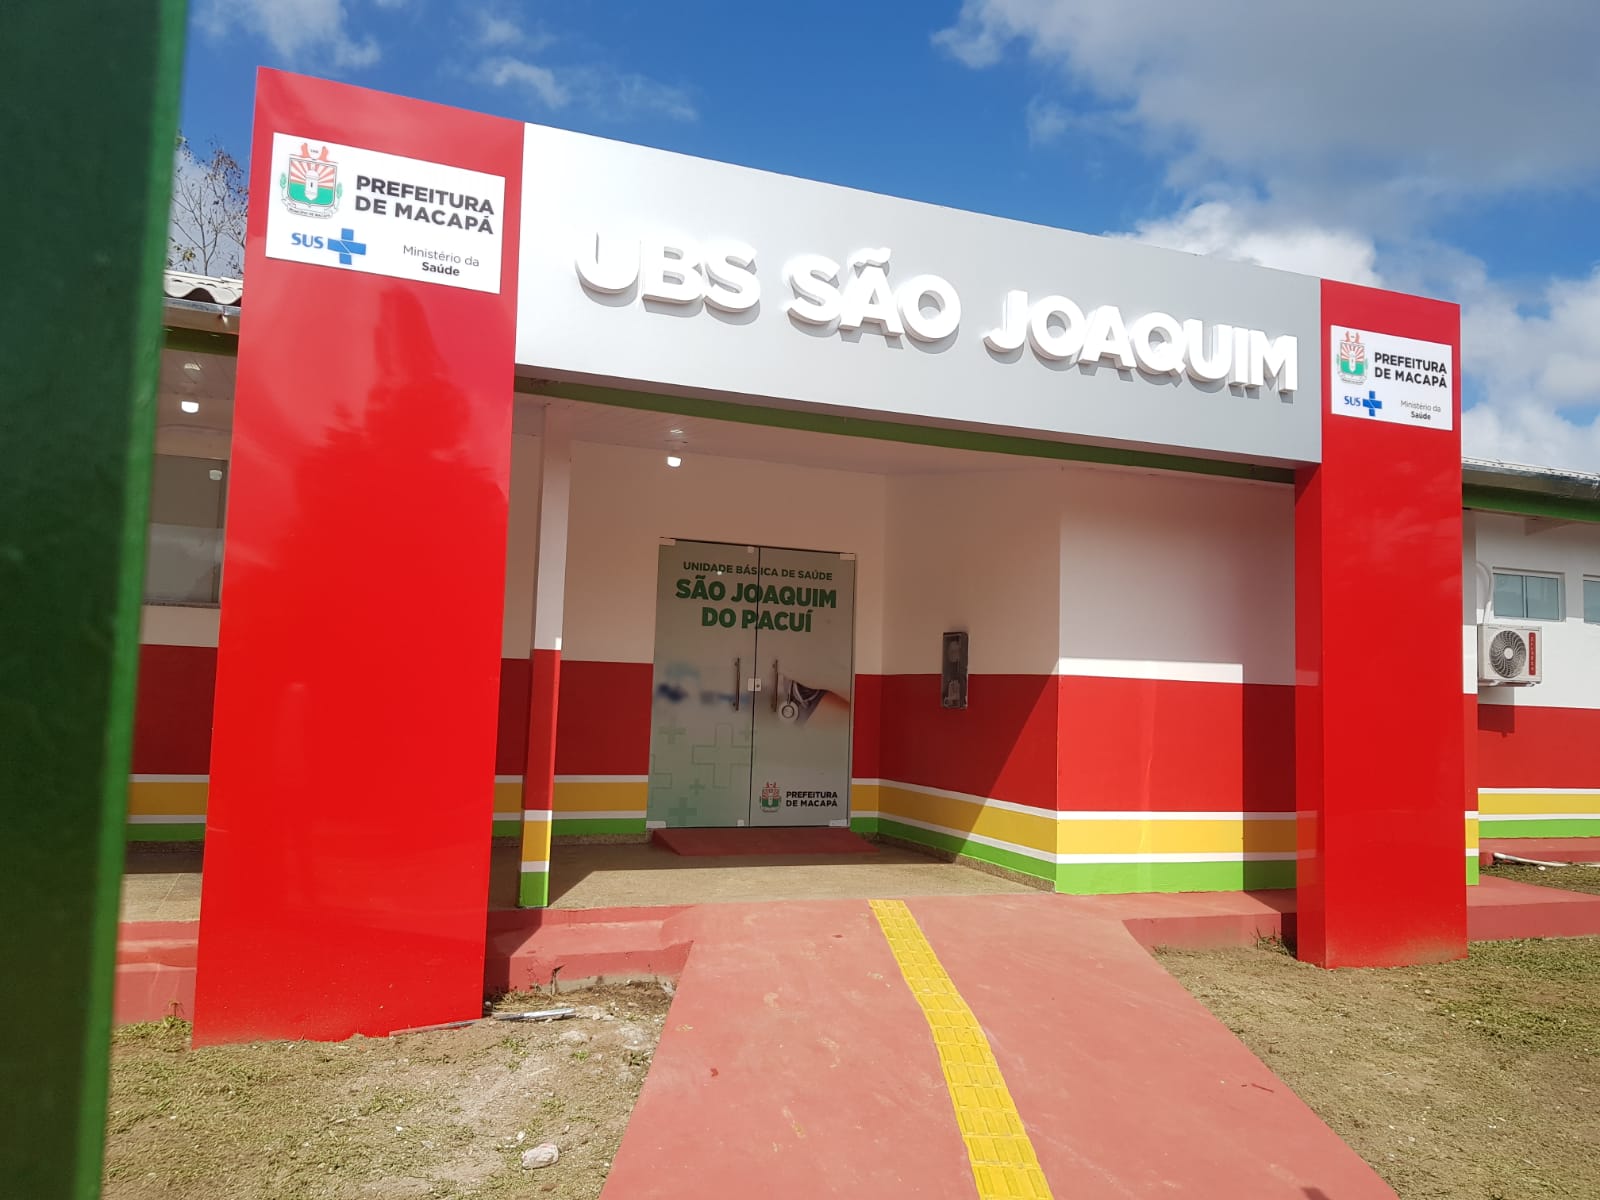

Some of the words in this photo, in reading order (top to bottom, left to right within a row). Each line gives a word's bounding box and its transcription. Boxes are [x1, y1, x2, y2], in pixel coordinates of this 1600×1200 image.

[356, 174, 494, 215] PREFEITURA
[355, 195, 387, 216] DE
[395, 202, 494, 235] MACAPÁ
[290, 232, 324, 249] SUS
[402, 245, 462, 264] Ministério
[464, 255, 480, 267] da
[421, 261, 460, 277] Saúde
[575, 232, 760, 314] UBS
[784, 247, 961, 342] SÃO
[982, 289, 1298, 395] JOAQUIM
[1374, 352, 1447, 374] PREFEITURA
[1374, 367, 1392, 380] DE
[1395, 370, 1448, 388] MACAPÁ
[1344, 395, 1361, 407] SUS
[1400, 400, 1432, 411] Ministério
[1432, 404, 1442, 413] da
[1410, 410, 1431, 421] Saúde
[683, 561, 733, 574] UNIDADE
[736, 564, 778, 577] BÁSICA
[781, 569, 795, 578] DE
[798, 569, 833, 581] SAÚDE
[675, 575, 726, 602] SÃO
[731, 583, 837, 608] JOAQUIM
[702, 606, 737, 628] DO
[742, 608, 813, 632] PACUÍ
[786, 791, 838, 799] PREFEITURA
[800, 799, 838, 807] MACAPÁ
